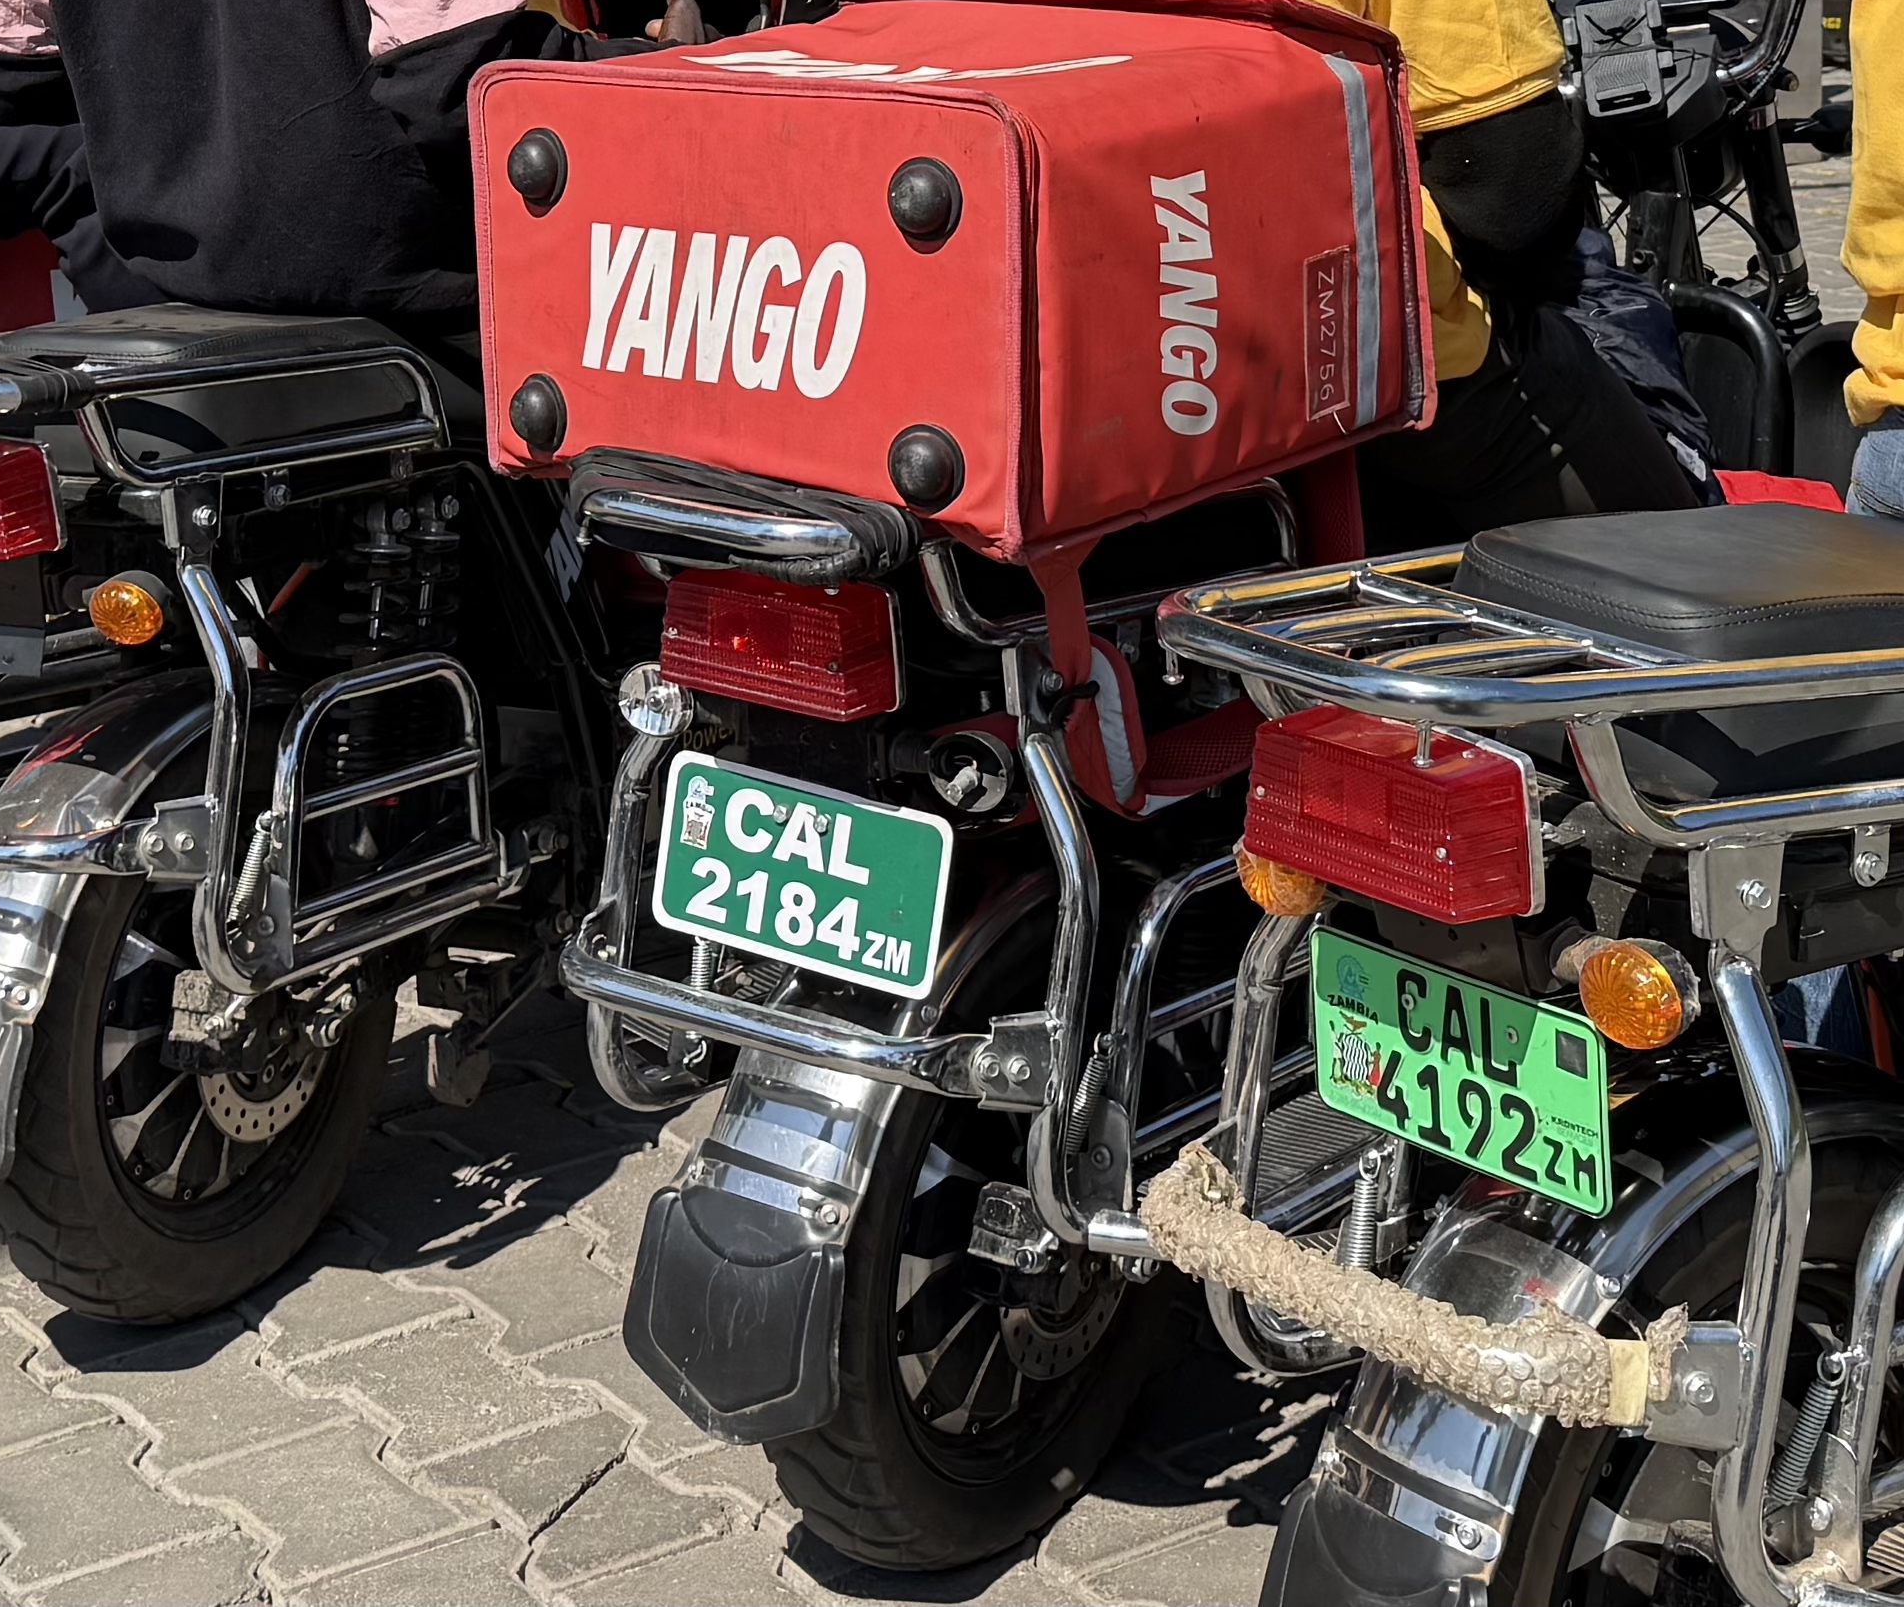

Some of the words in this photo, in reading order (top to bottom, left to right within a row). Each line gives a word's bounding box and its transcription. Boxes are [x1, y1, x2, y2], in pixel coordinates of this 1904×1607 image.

[582, 222, 867, 399] YANGO
[1150, 169, 1218, 436] YANGO
[1316, 266, 1337, 402] ZM2756
[724, 788, 870, 886] CAL
[1326, 994, 1380, 1025] ZAMBIA
[1396, 967, 1518, 1088] CAL
